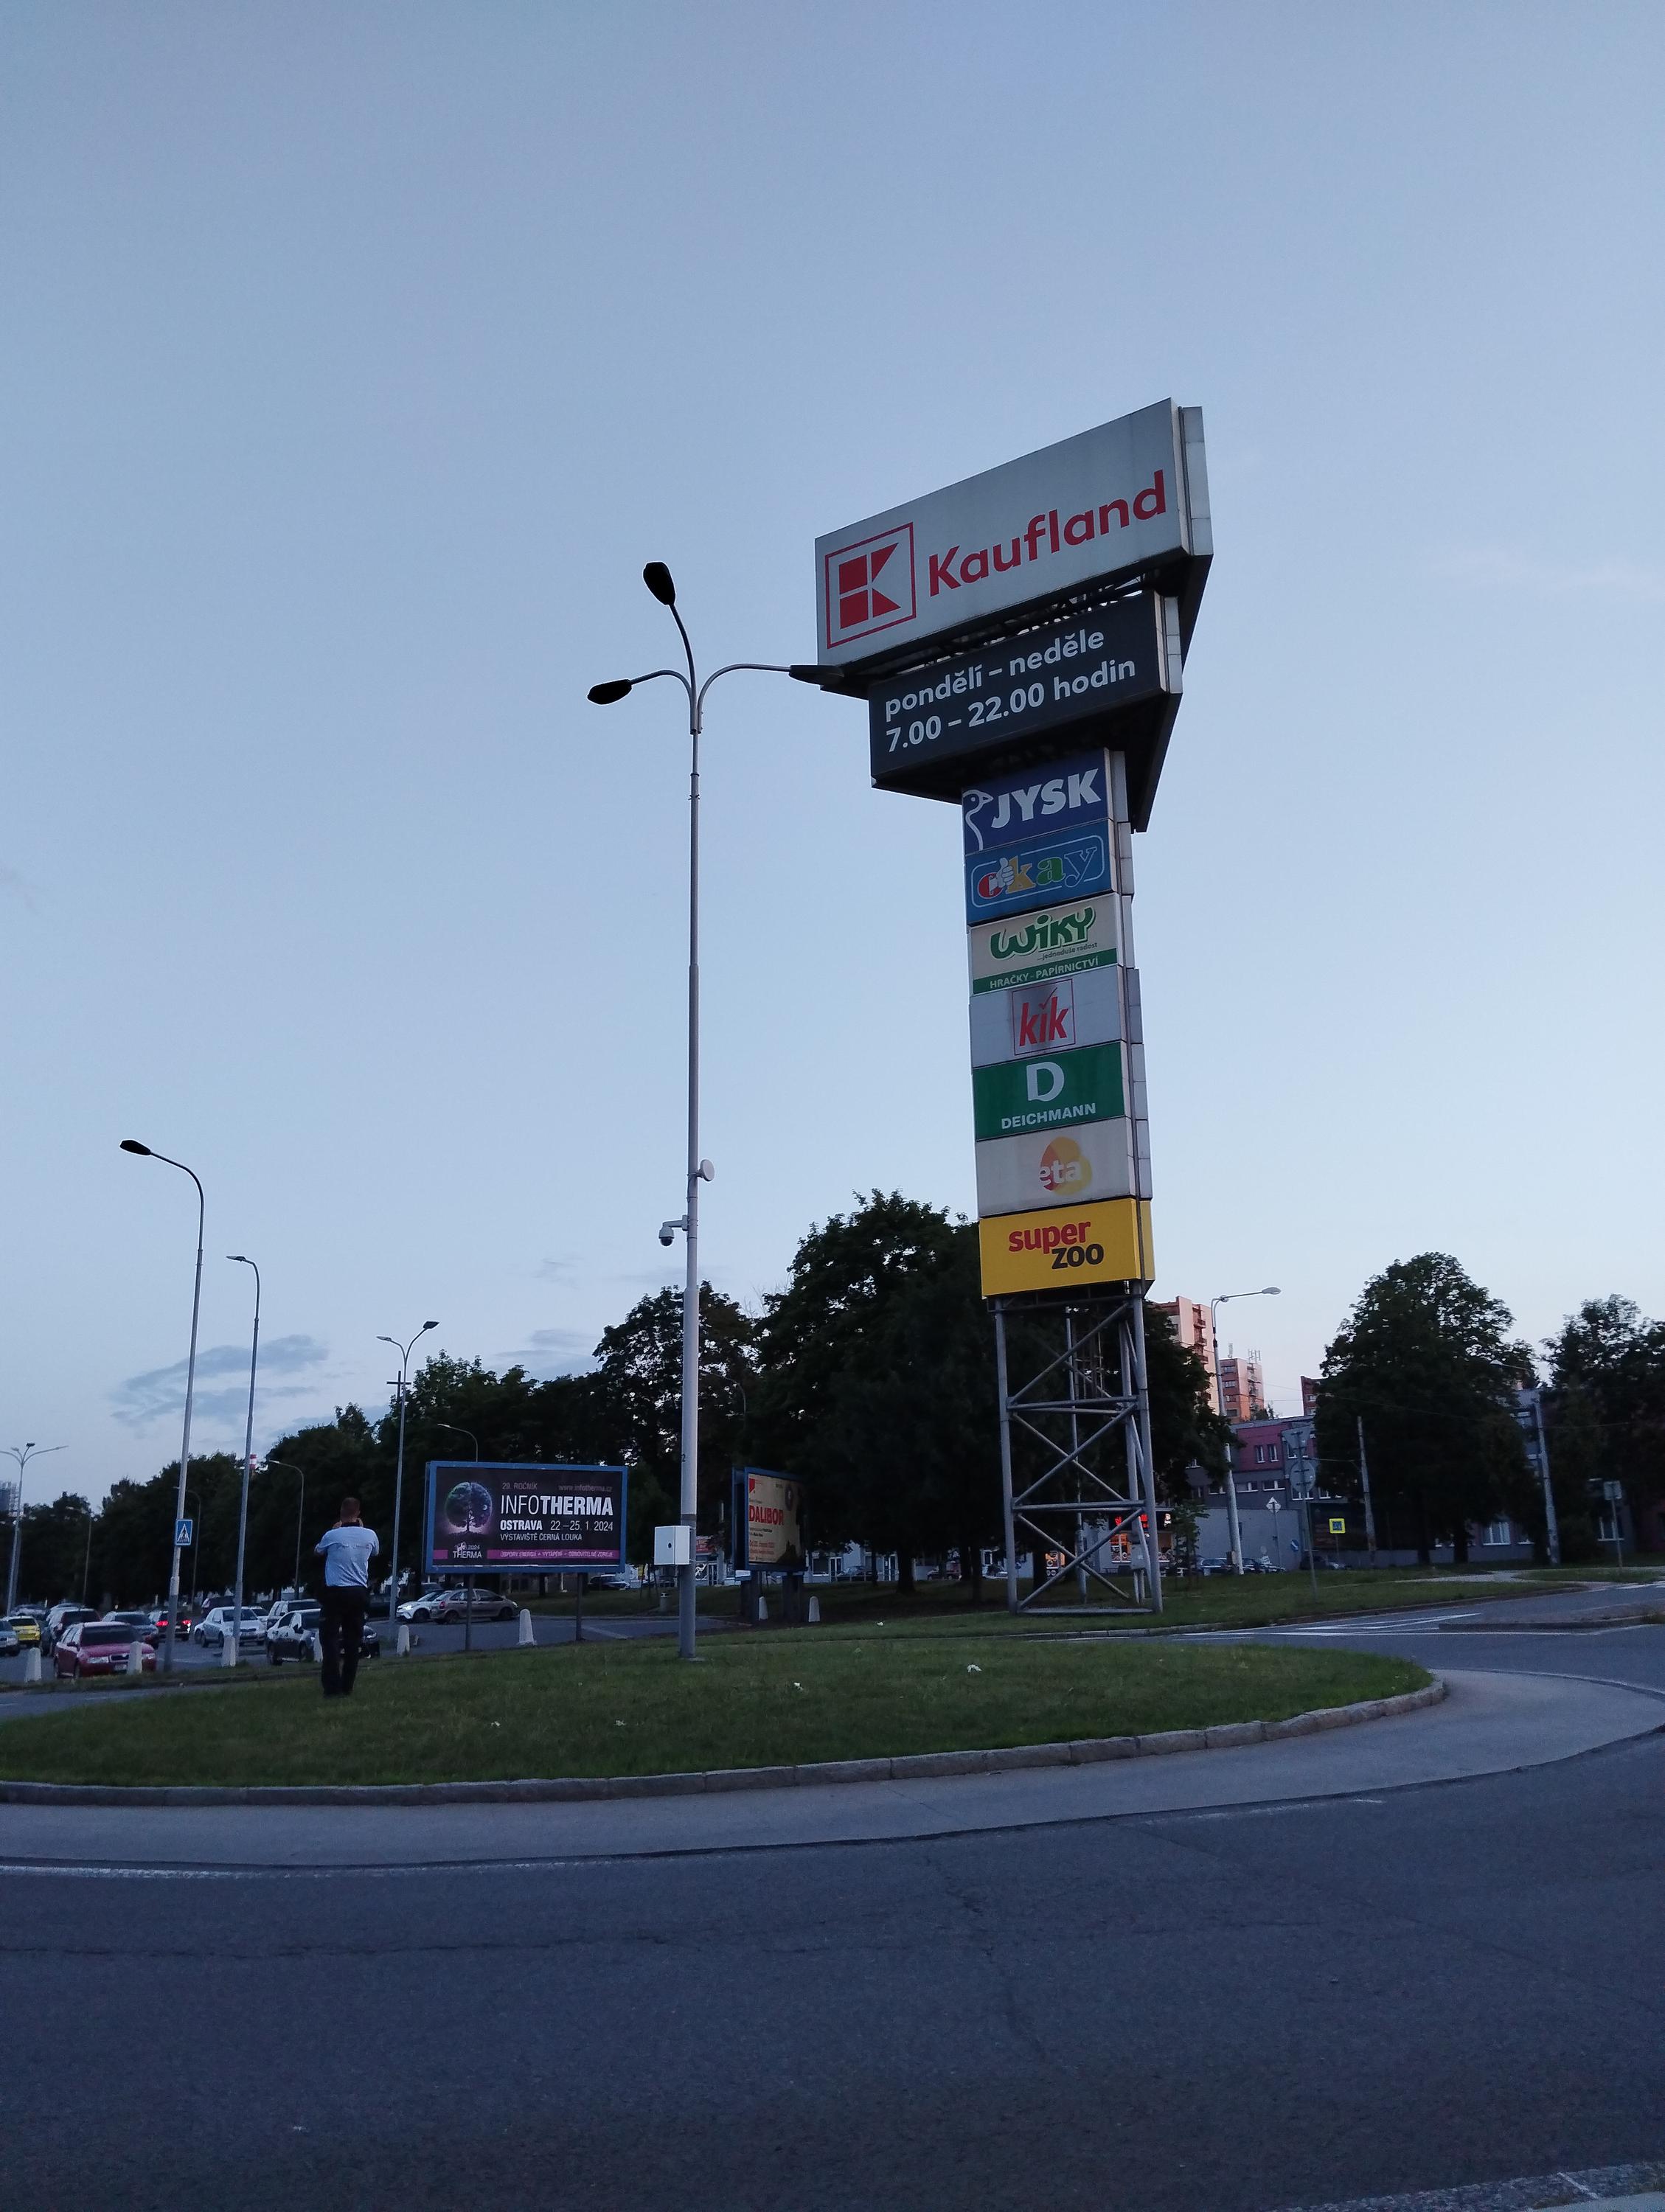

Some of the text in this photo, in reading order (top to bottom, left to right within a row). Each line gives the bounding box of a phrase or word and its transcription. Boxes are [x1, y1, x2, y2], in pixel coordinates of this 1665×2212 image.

[929, 470, 1167, 597] Kaufland
[886, 664, 983, 723] pondělí
[1009, 628, 1105, 677] neděle
[886, 714, 942, 754] 7.00
[967, 683, 1045, 728] 22.00
[1054, 659, 1136, 701] hodin
[991, 768, 1102, 829] JYSK
[990, 965, 1029, 990] HRAČKY
[1035, 955, 1099, 980] PAPÍRNICTVÍ
[1019, 987, 1069, 1047] kik
[1001, 1102, 1096, 1130] DEICHMANN
[1038, 1159, 1083, 1187] eta
[1008, 1221, 1091, 1254] super
[500, 1520, 543, 1531] OSTRAVA
[594, 1520, 613, 1532] 2024
[749, 1505, 785, 1526] DALIBOR
[538, 1532, 560, 1542] ČERNÁ
[561, 1533, 583, 1542] LOUKA
[452, 1550, 483, 1559] THERMA
